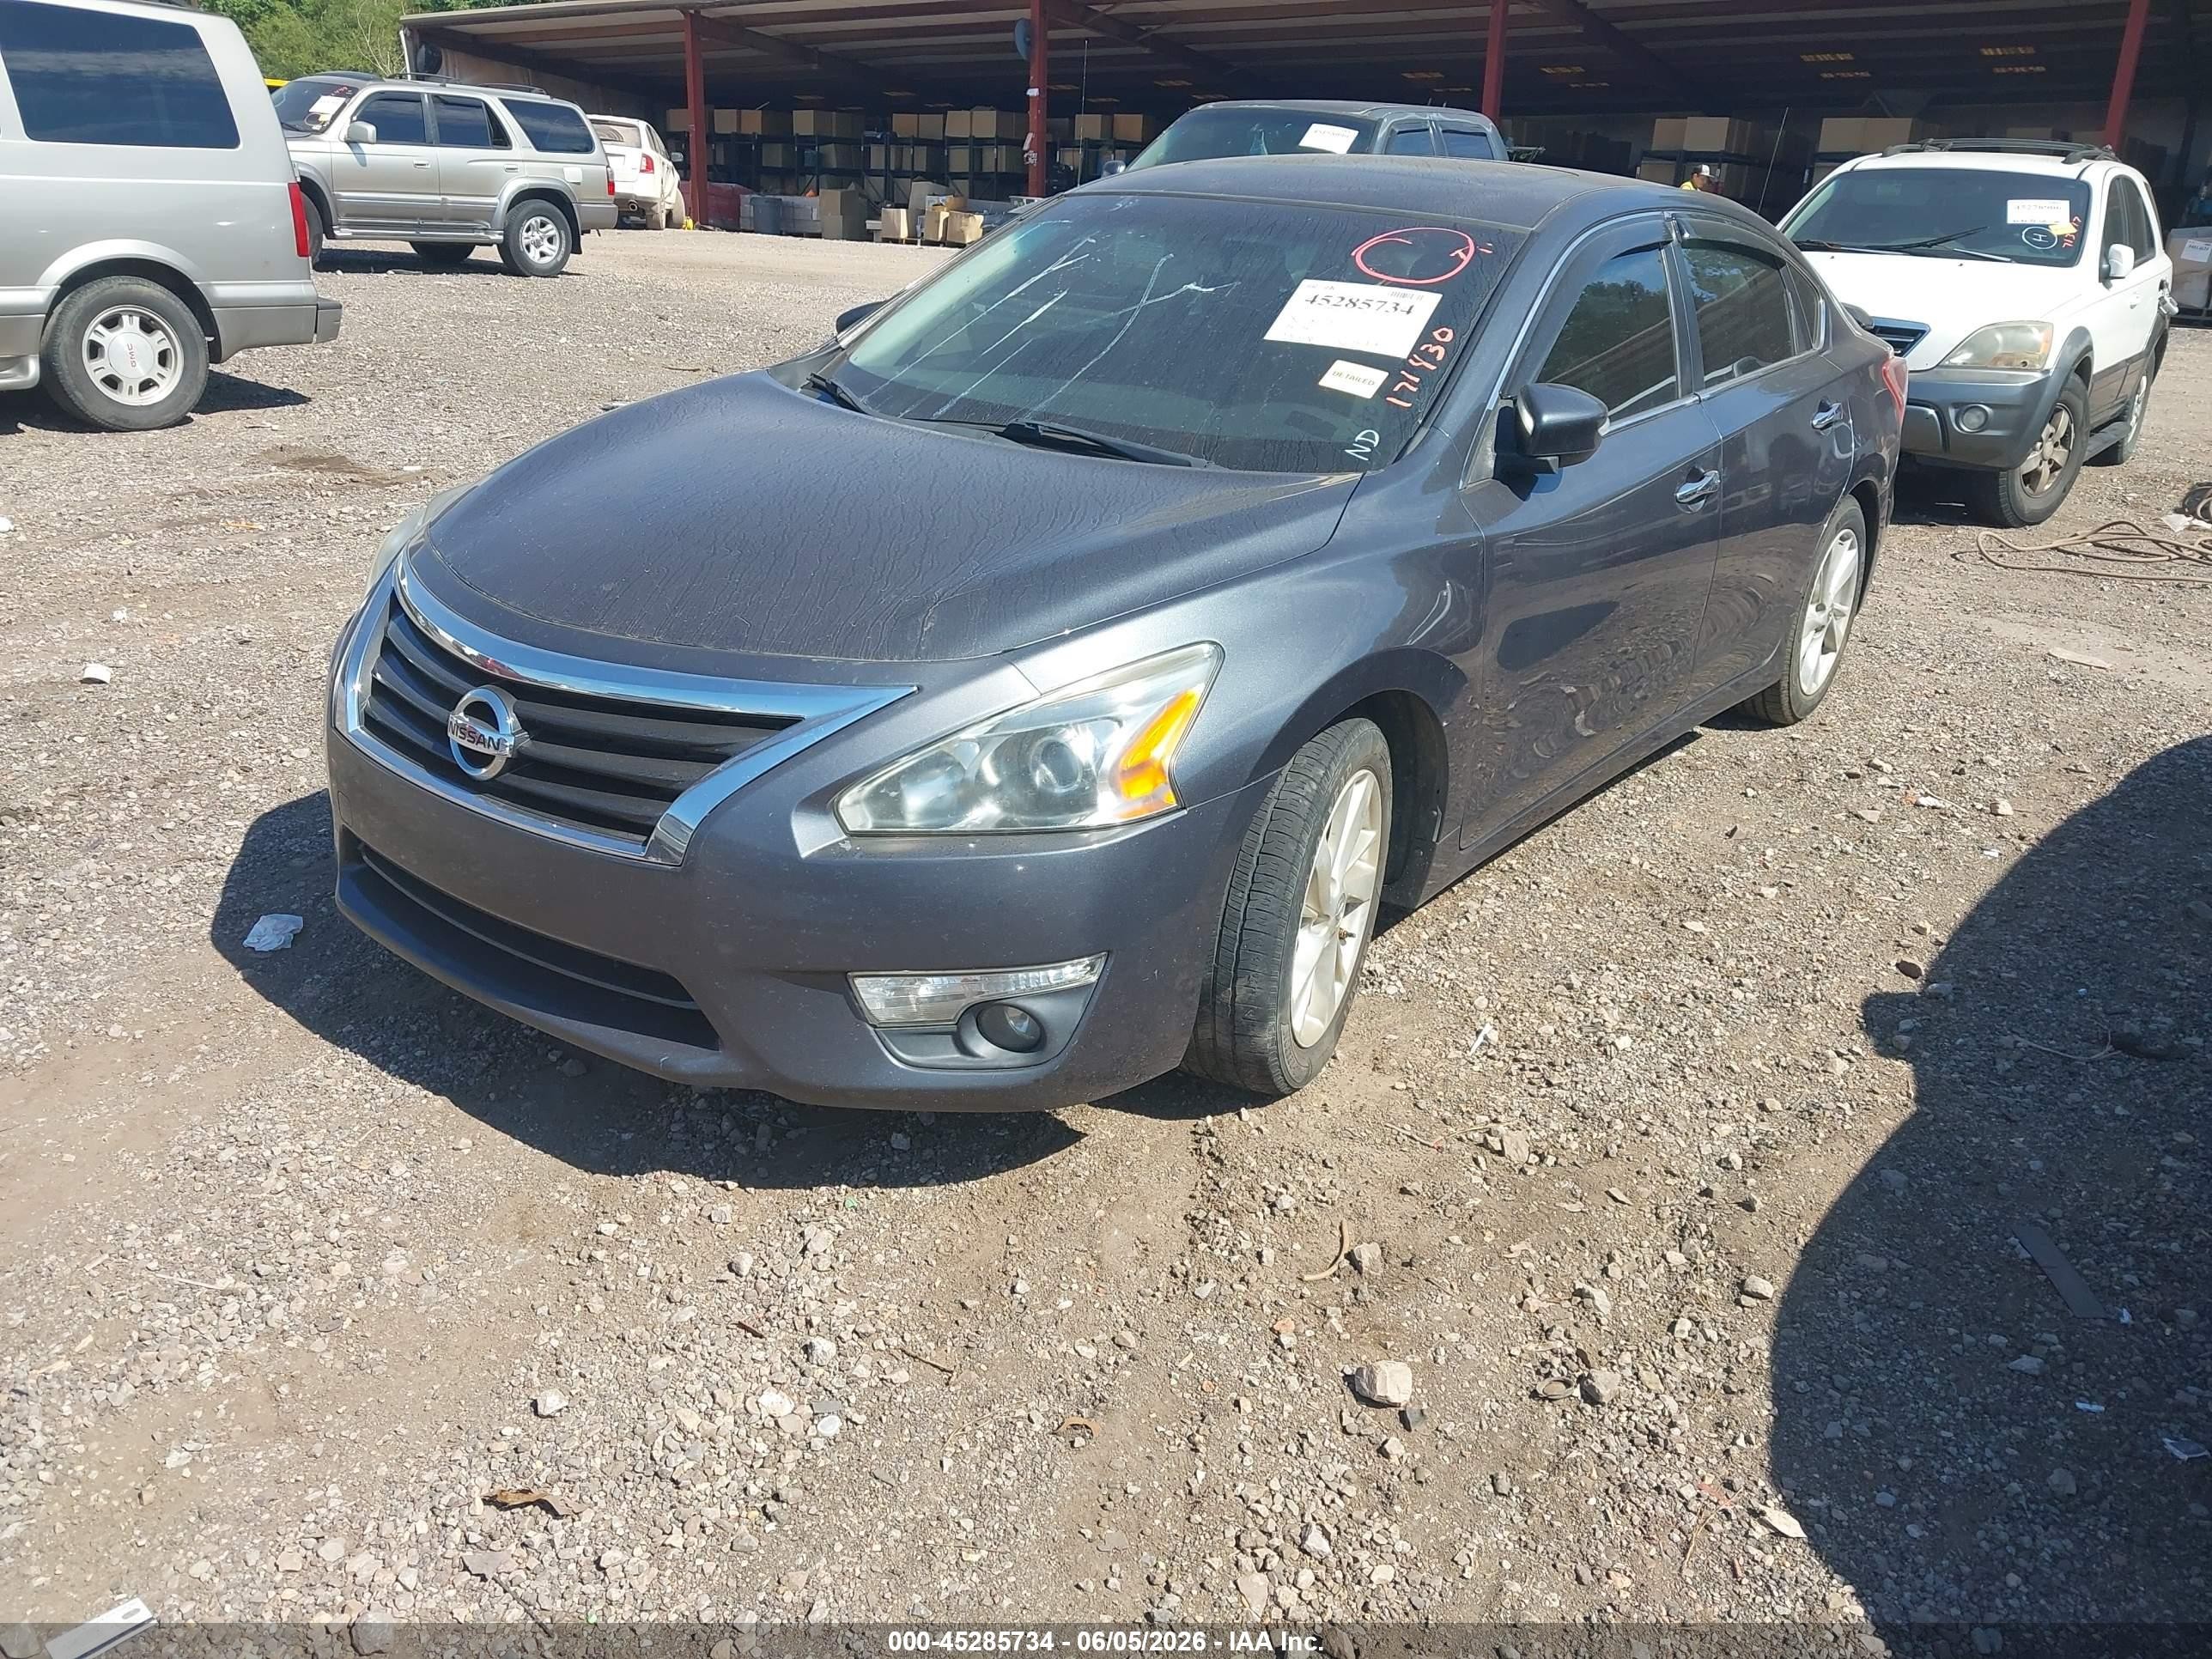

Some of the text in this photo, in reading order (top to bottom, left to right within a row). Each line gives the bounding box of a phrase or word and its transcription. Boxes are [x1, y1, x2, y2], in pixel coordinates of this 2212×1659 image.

[1304, 294, 1415, 315] 45285734
[126, 343, 137, 368] GMC
[1331, 370, 1376, 386] DETAILED
[1345, 429, 1380, 461] ND
[448, 720, 501, 751] NISSAN
